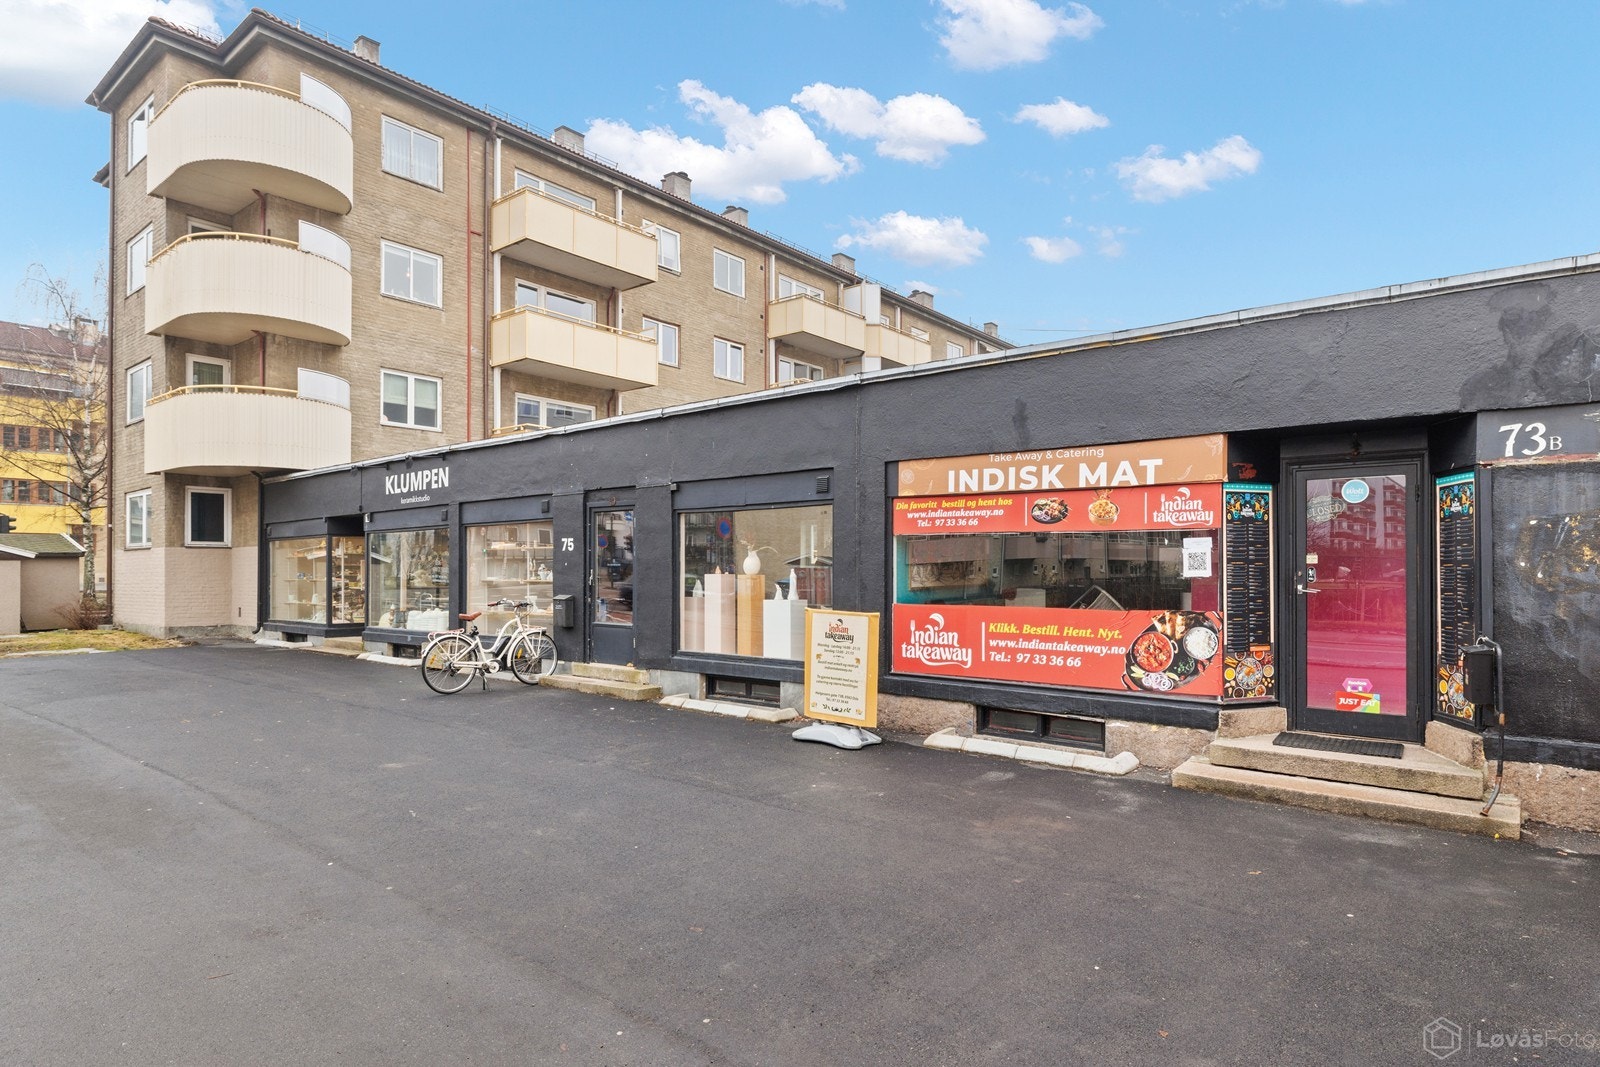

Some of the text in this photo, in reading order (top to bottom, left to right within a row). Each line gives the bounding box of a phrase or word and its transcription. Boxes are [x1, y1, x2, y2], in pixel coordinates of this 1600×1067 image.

[989, 447, 1104, 462] Take Away & Catering
[385, 466, 449, 495] KLUMPEN
[948, 458, 1163, 493] INDISK MAT
[896, 497, 1013, 511] Din favoritt bestill og hent hos
[907, 508, 1004, 518] www.indiantakeaway.no
[1153, 509, 1213, 527] takeaway
[934, 519, 945, 527] 97
[946, 518, 956, 526] 33
[957, 518, 967, 526] 36
[968, 517, 978, 526] 66
[561, 537, 574, 552] 75
[824, 631, 854, 644] takeaway
[989, 622, 1123, 641] Klikk. Bestill. Hent. Nyt.
[989, 638, 1126, 656] www.indiantakeaway.no
[901, 641, 972, 669] takeaway
[1016, 653, 1031, 663] 97
[1032, 654, 1047, 665] 33
[1049, 656, 1064, 666] 36
[1066, 657, 1081, 667] 66
[1338, 697, 1375, 707] JUST EAT
